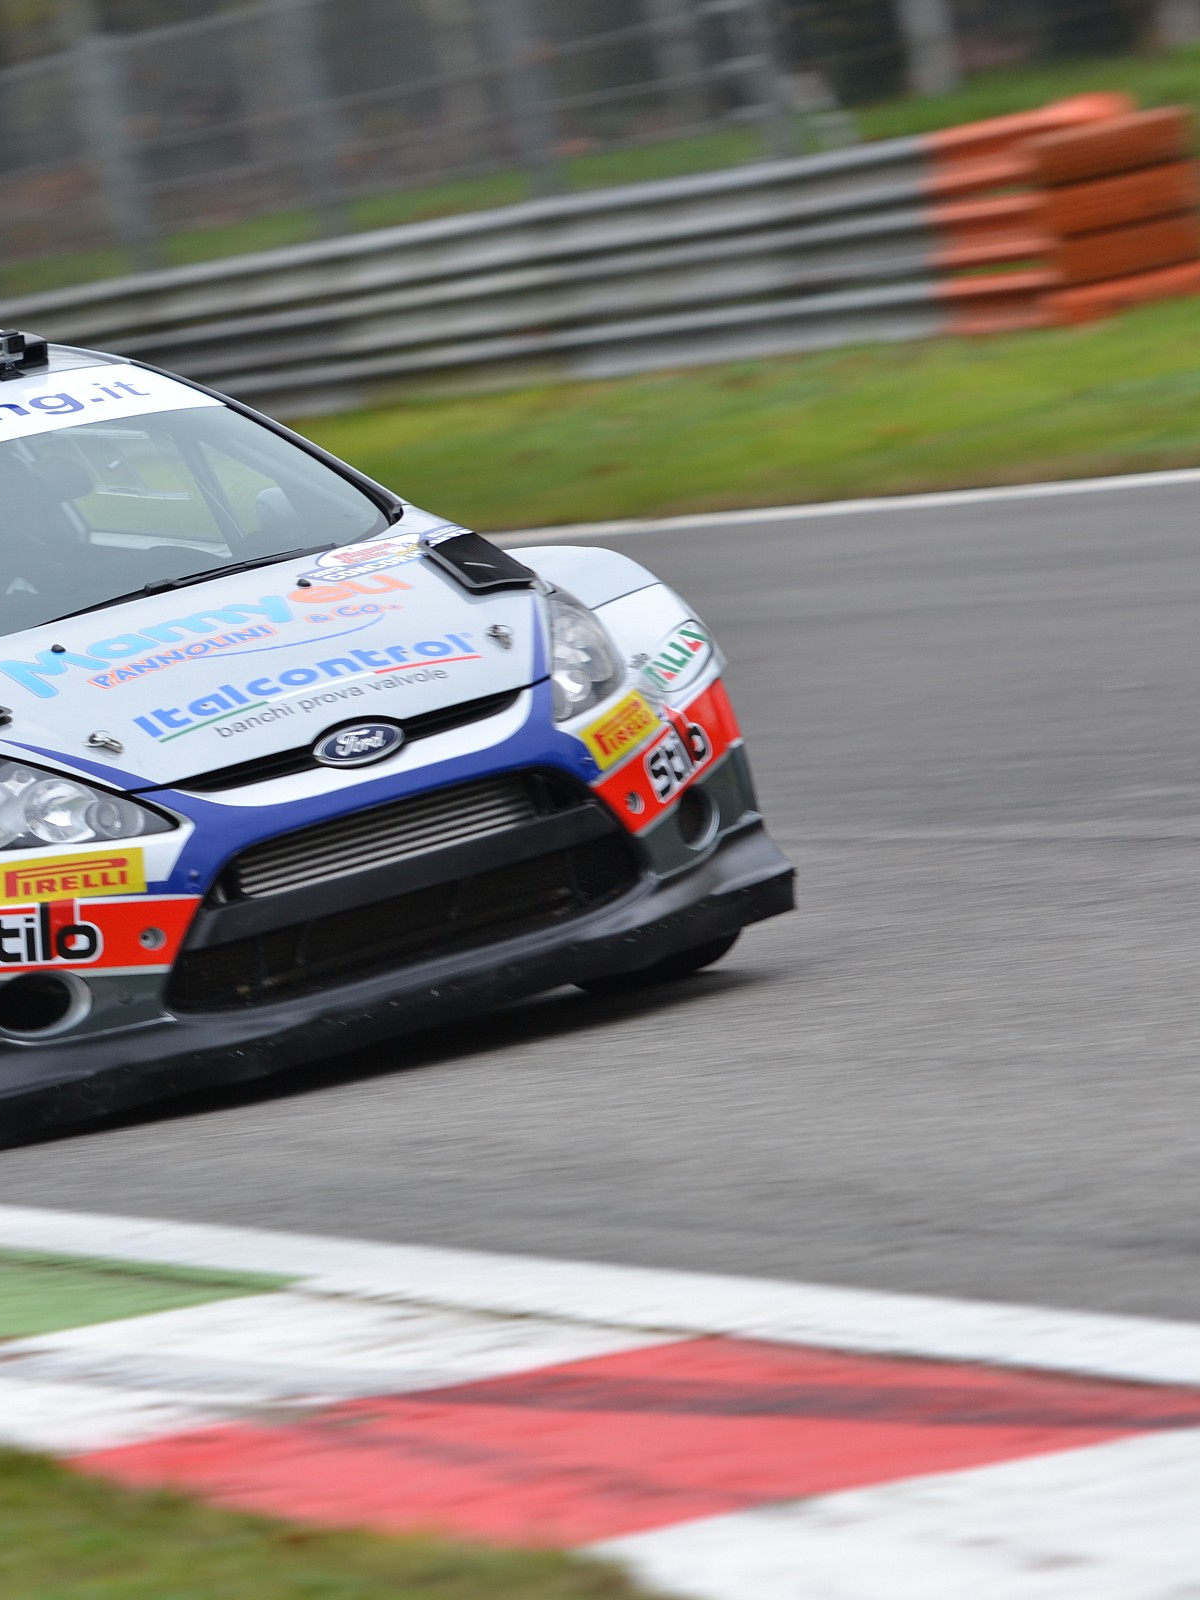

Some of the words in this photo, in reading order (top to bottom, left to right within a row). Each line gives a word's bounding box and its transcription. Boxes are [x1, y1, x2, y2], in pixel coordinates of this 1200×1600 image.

[87, 624, 278, 690] PANNOLINI
[132, 634, 478, 738] Italcontrol
[213, 702, 295, 738] banchi
[297, 685, 366, 714] prova
[367, 667, 450, 692] valvole
[4, 857, 129, 898] PIRELLI
